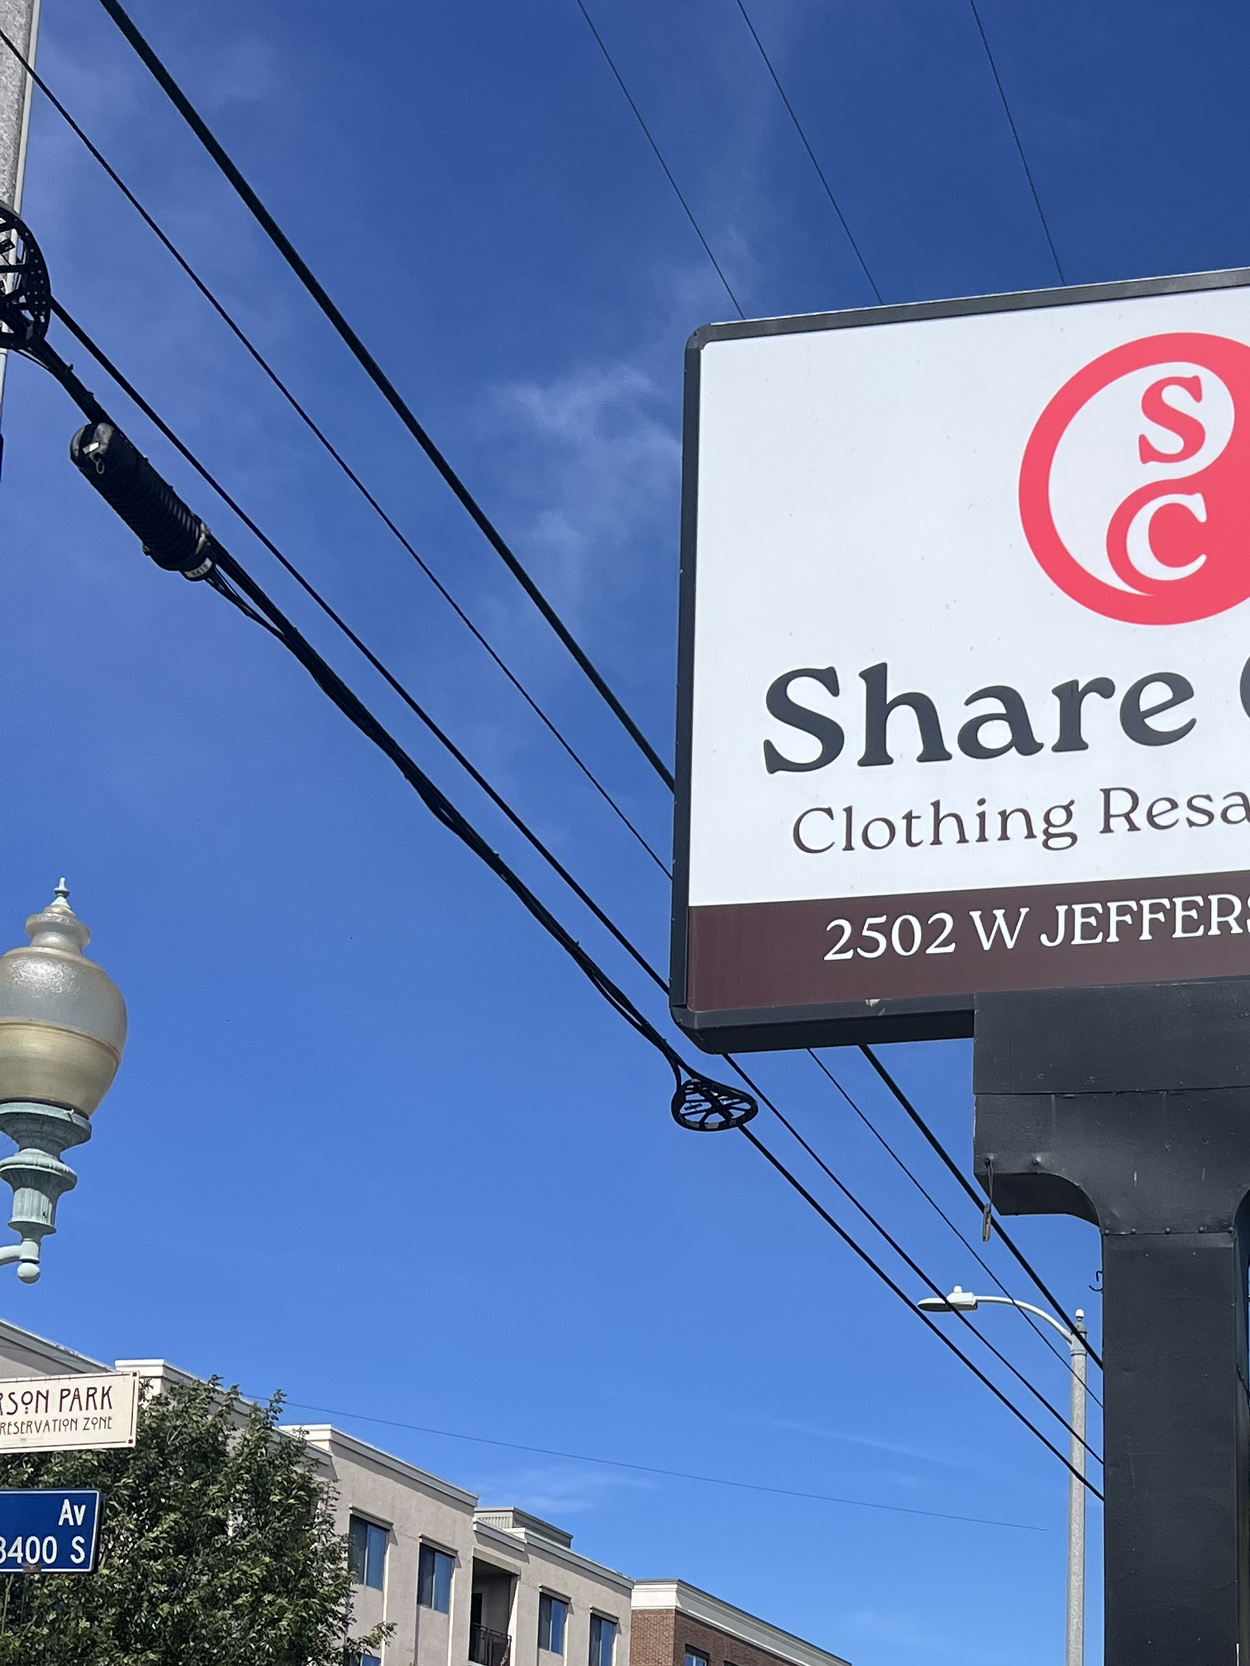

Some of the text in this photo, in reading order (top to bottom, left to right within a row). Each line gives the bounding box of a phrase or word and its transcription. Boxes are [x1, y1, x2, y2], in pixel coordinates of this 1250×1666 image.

[1138, 375, 1207, 465] S
[1125, 492, 1207, 582] C
[763, 661, 1197, 775] Share
[792, 798, 1078, 854] Clothing
[823, 912, 956, 961] 2502
[968, 907, 1030, 952] W
[0, 1385, 113, 1416] SON PARK
[82, 1416, 113, 1431] ZONE
[58, 1498, 87, 1526] Av
[70, 1535, 86, 1564] S
